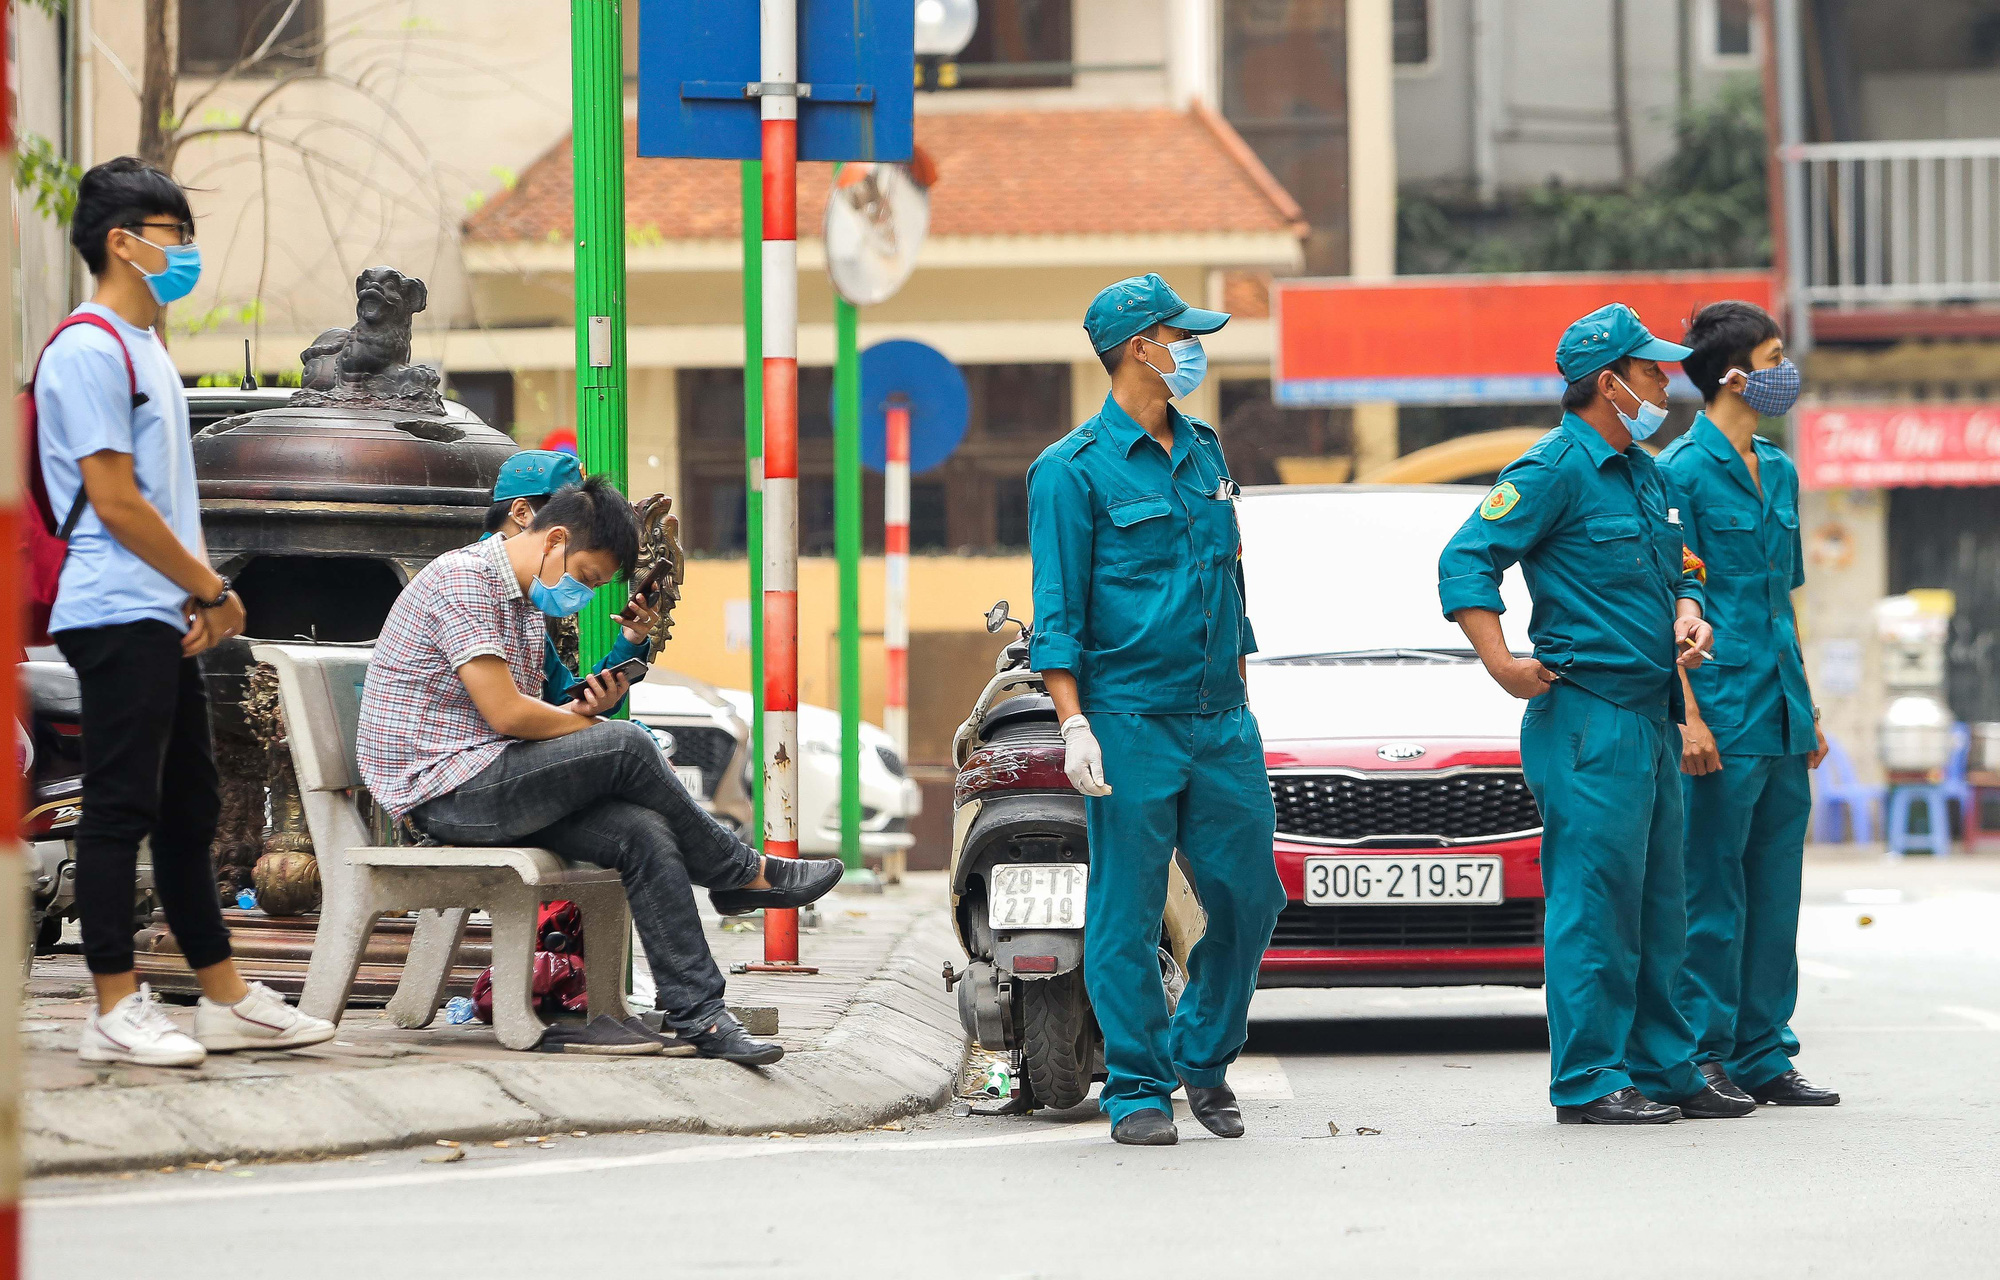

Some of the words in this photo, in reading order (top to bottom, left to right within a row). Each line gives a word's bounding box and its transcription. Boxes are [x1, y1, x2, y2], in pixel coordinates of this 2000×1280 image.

[1005, 868, 1074, 895] 29-T1
[1312, 863, 1494, 898] 30G-219.57
[1004, 897, 1073, 924] 2719
